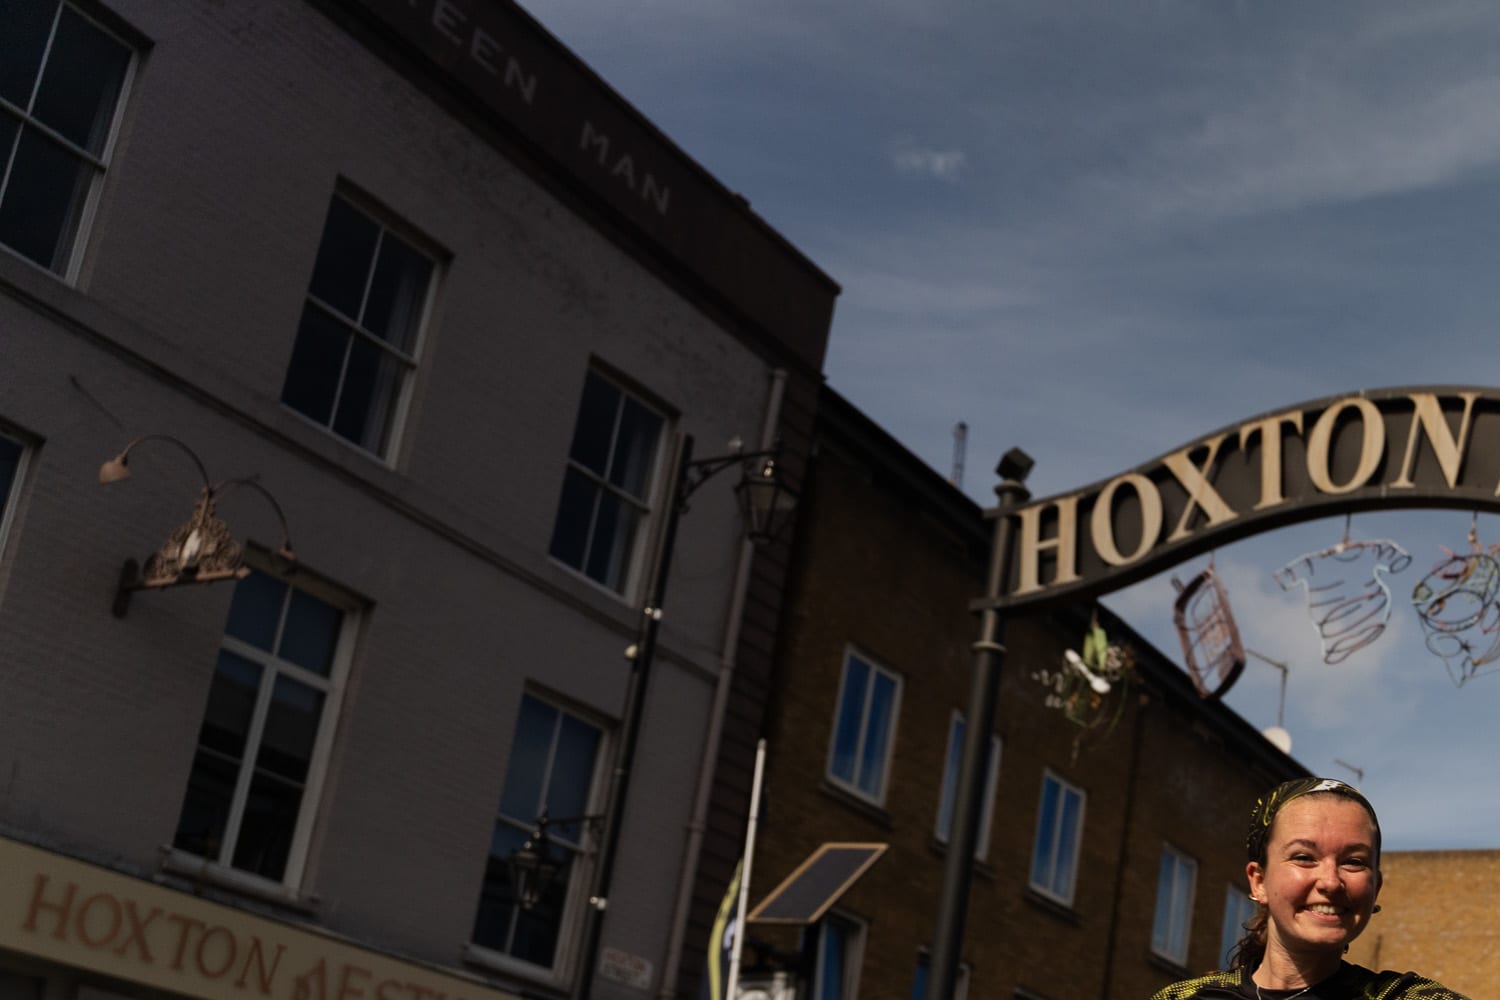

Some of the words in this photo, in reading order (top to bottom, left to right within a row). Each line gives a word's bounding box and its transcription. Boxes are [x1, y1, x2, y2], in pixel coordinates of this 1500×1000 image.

[408, 0, 537, 104] EEN
[579, 120, 671, 216] MAN
[1008, 393, 1473, 595] HOXTON
[21, 872, 288, 996] HOXTON
